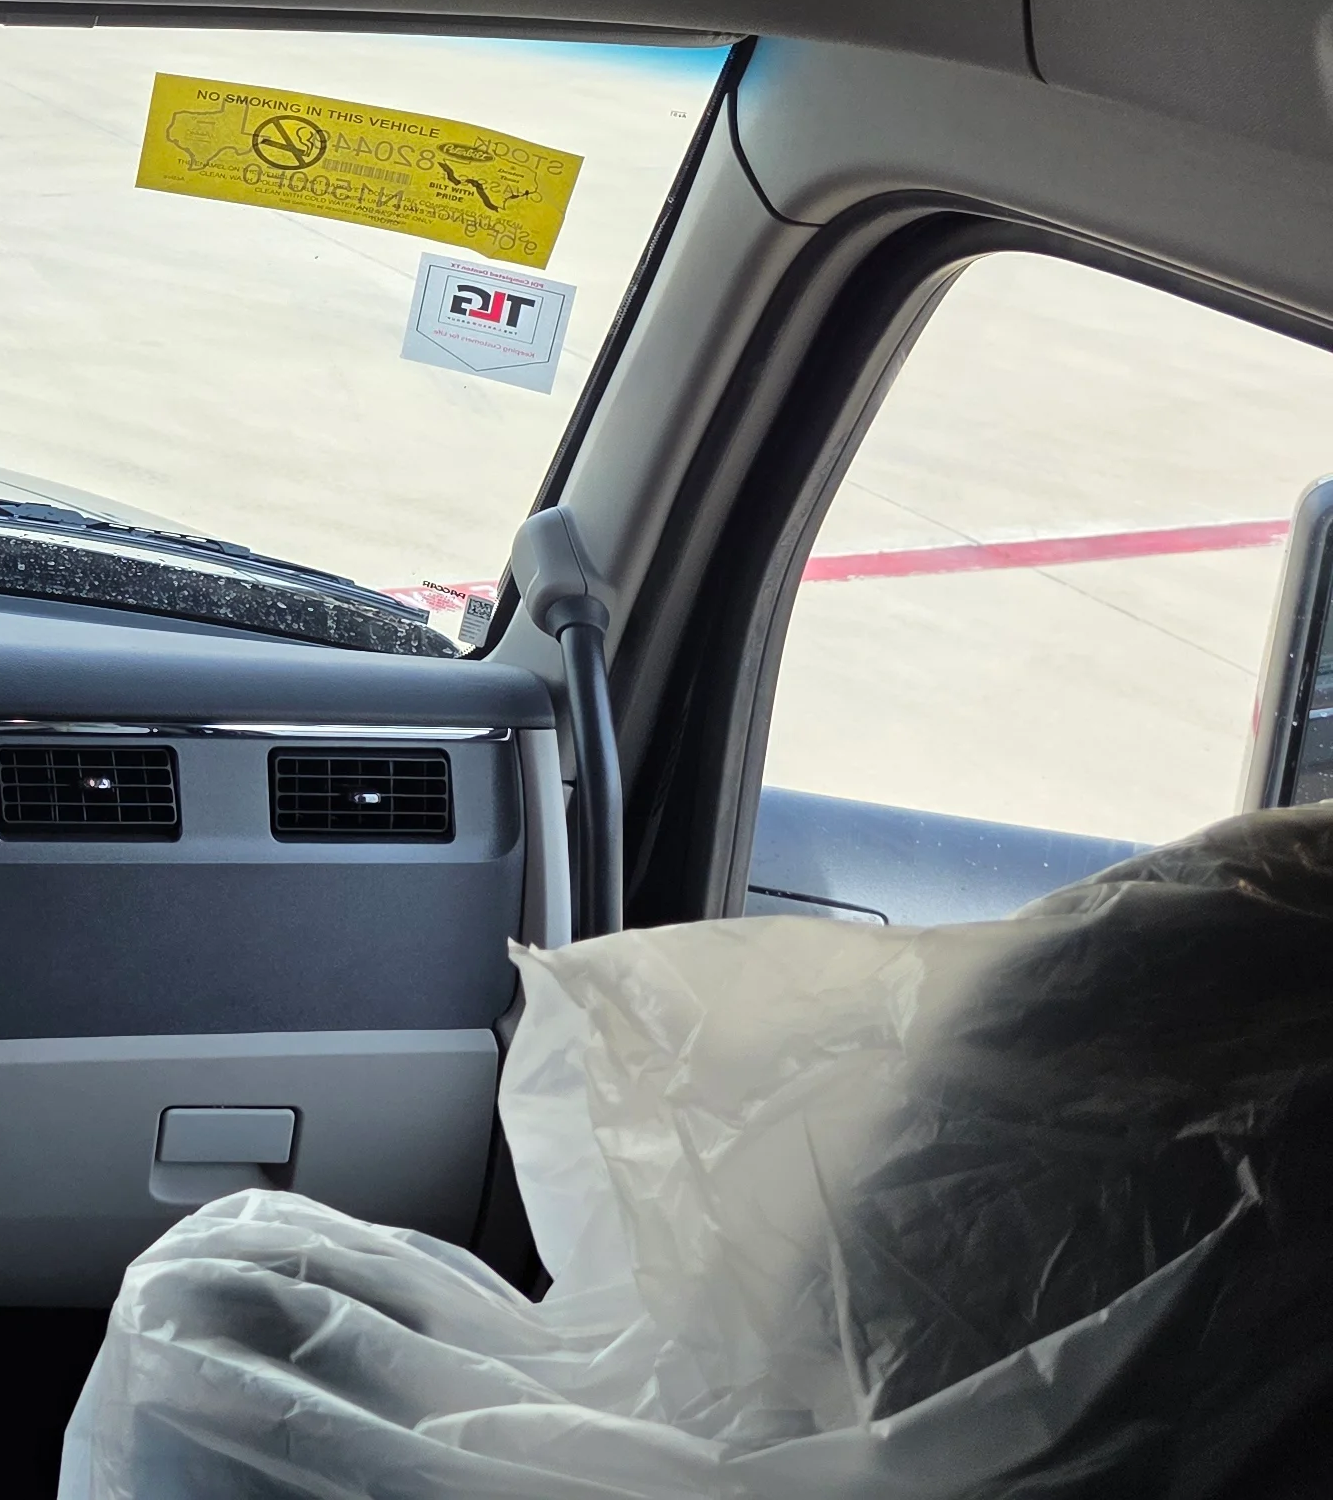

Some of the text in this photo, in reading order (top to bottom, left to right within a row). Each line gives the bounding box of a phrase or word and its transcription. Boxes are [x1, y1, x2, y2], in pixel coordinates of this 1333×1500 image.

[196, 89, 441, 139] NO SMOKING IN THIS VEHICLE
[429, 182, 475, 197] BILT WITH
[305, 195, 326, 203] COLD
[436, 192, 464, 203] PRIDE
